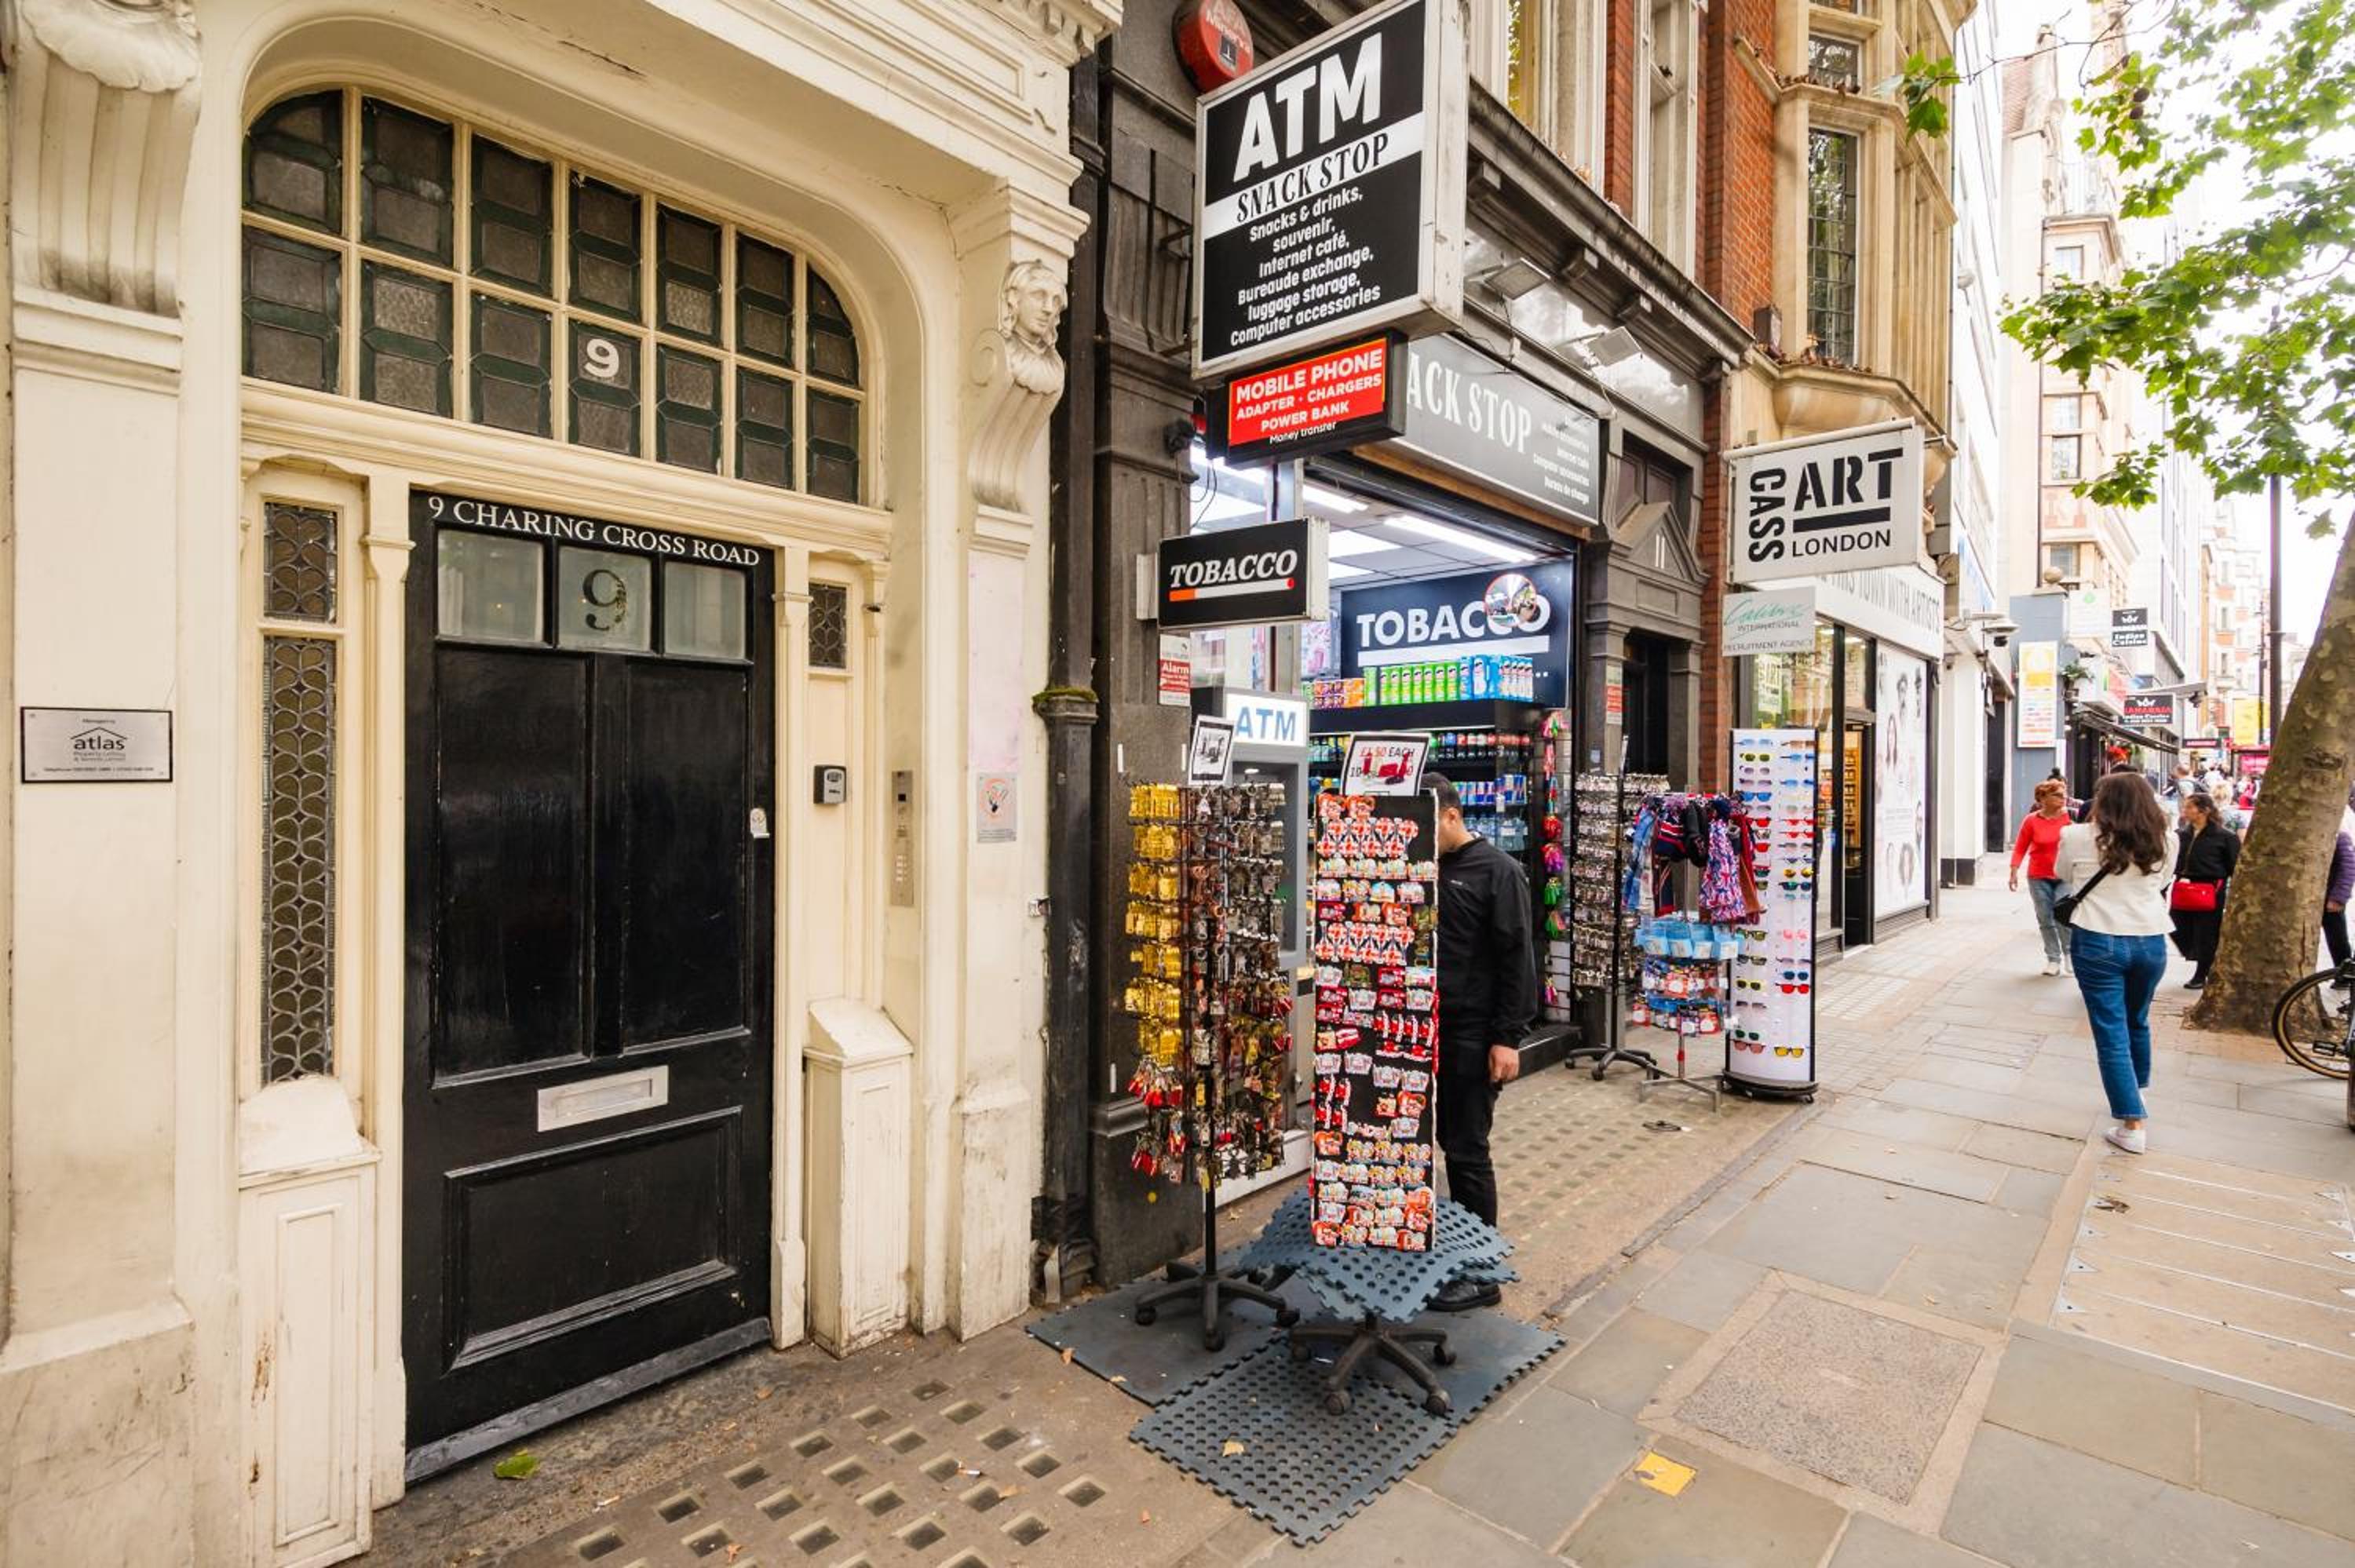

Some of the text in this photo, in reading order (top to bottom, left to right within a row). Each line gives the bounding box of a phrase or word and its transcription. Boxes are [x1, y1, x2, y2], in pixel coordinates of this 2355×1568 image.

[1233, 31, 1382, 183] ATM
[1236, 132, 1389, 224] SNACK STOP
[1249, 186, 1364, 242] Snacks & drinks,
[1258, 244, 1313, 279] Internet
[1301, 245, 1375, 282] exchange,
[1230, 284, 1382, 347] Computer accessories
[1247, 272, 1360, 323] luggage storage,
[584, 337, 620, 378] 9
[1236, 348, 1382, 404] MOBILE PHONE
[1236, 373, 1382, 421] ADAPTER CHARGERS
[1260, 399, 1350, 432] POWER BANK
[1407, 351, 1462, 426] ACK
[1468, 381, 1532, 454] STOP
[1269, 421, 1337, 445] Money transfer
[1794, 447, 1904, 512] ART
[428, 495, 761, 567] 9 CHARING CROSS ROAD
[1747, 467, 1787, 563] CASS
[1791, 528, 1892, 558] LONDON
[1169, 549, 1298, 589] TOBACCO
[582, 569, 627, 632] 9
[73, 735, 126, 751] atlas
[1234, 705, 1298, 742] ATM
